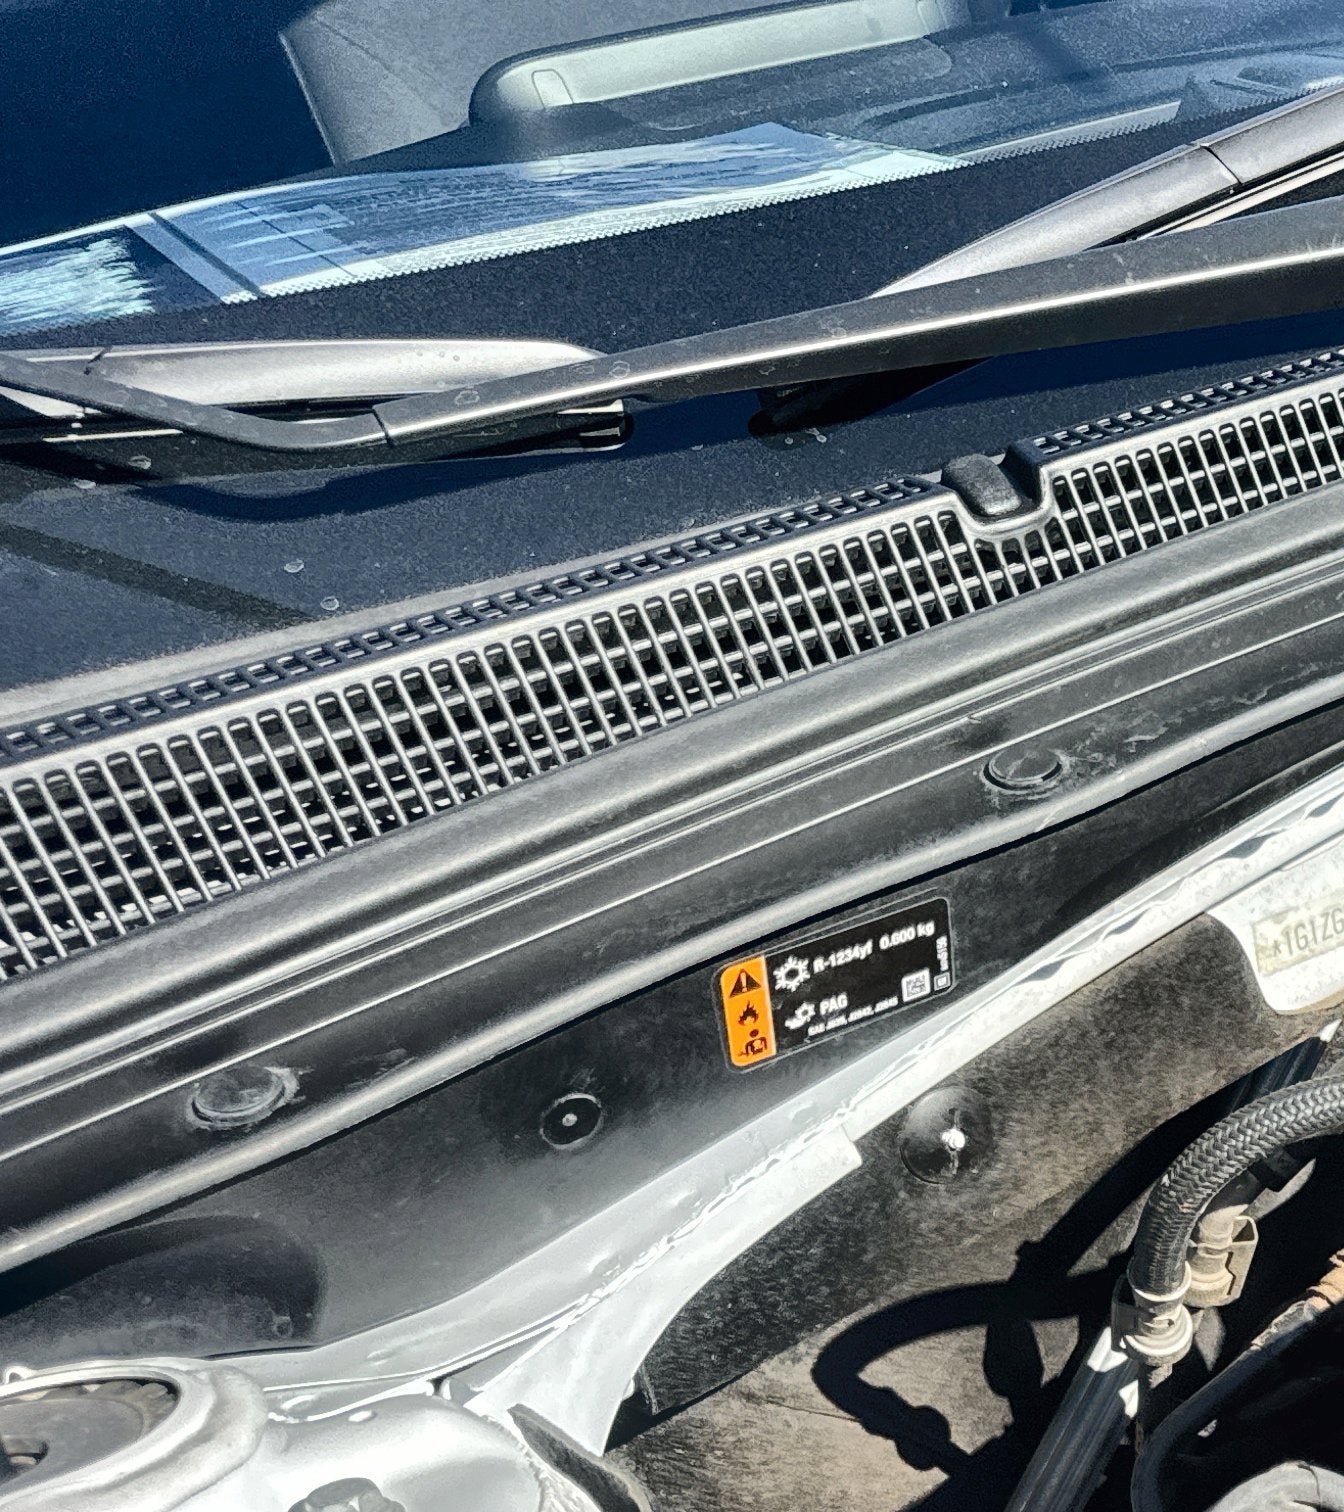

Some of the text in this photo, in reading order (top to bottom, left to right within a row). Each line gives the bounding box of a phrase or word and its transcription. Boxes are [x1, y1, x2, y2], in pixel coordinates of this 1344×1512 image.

[813, 938, 874, 974] R-1234yf
[916, 919, 936, 938] kg
[819, 991, 849, 1016] PAG
